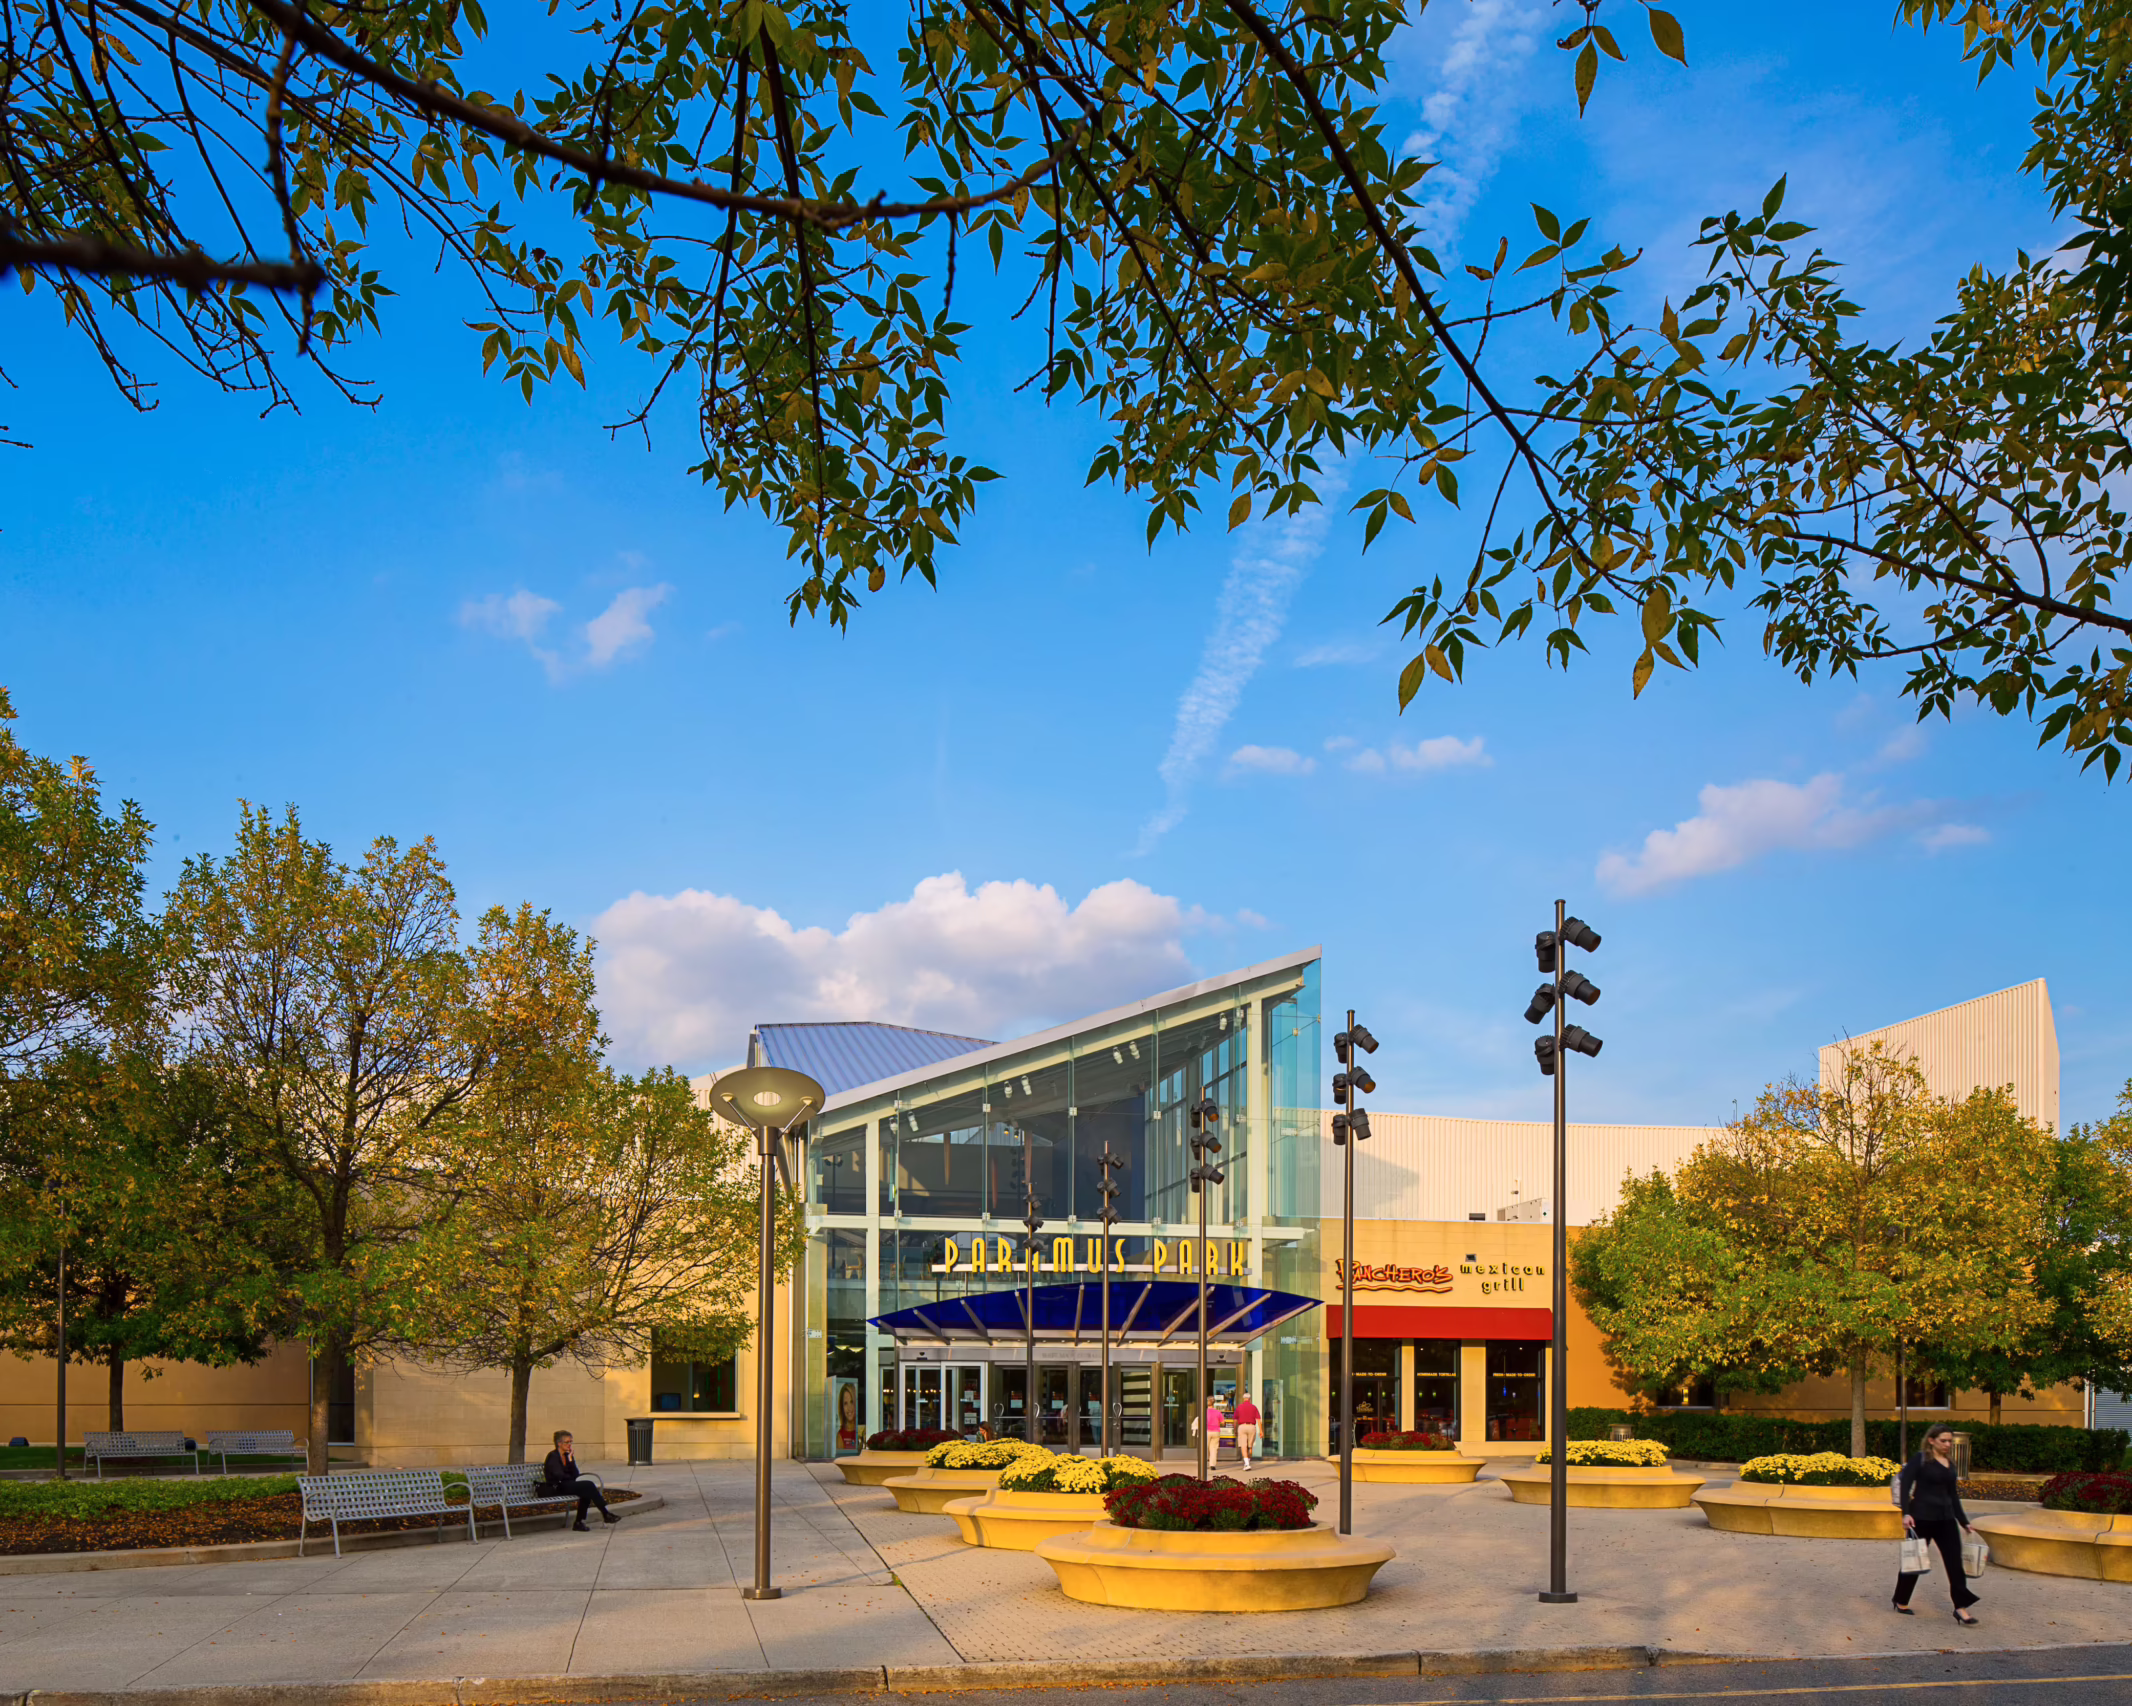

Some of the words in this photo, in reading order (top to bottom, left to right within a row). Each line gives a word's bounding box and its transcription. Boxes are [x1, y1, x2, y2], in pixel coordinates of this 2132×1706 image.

[1153, 1238, 1244, 1276] PARK
[1336, 1258, 1453, 1284] PANCHERO'S
[1460, 1262, 1545, 1275] mexican
[1482, 1277, 1525, 1294] grill
